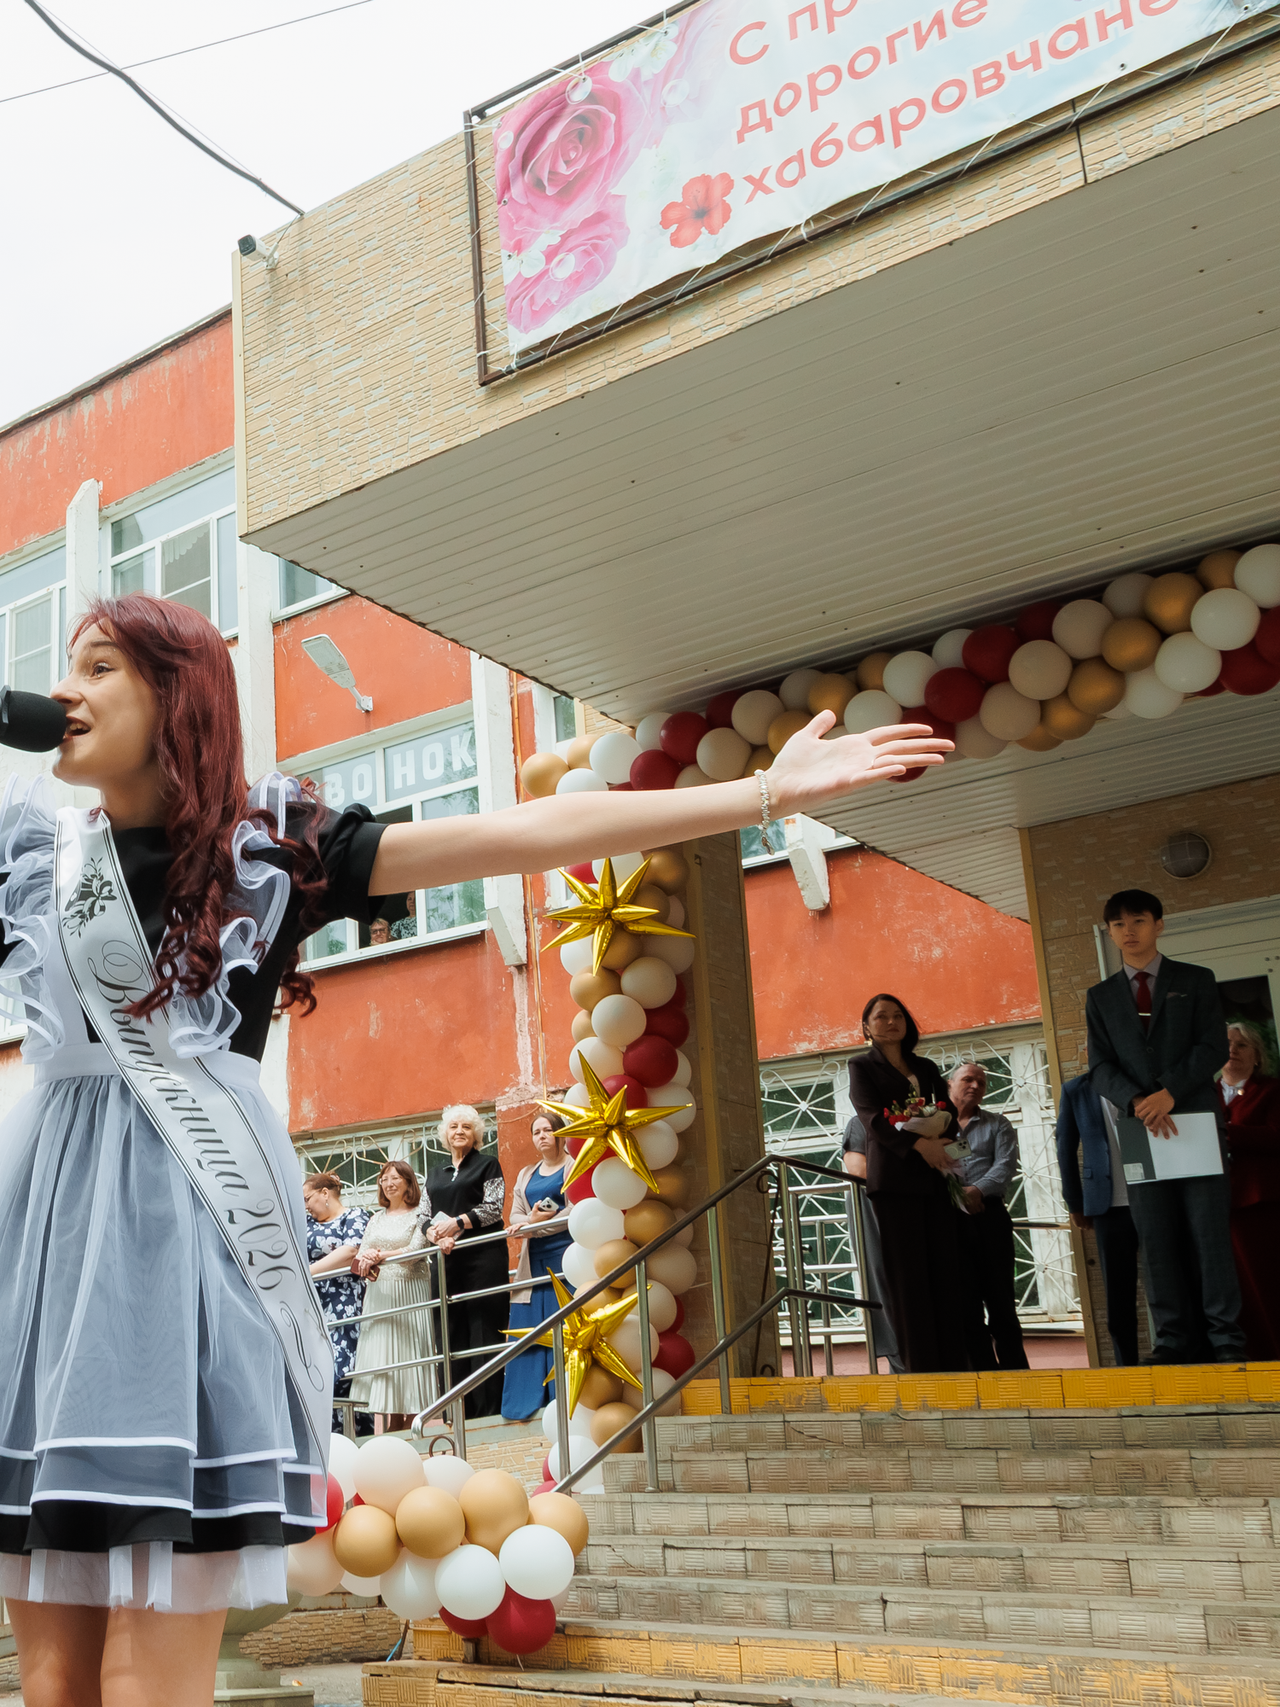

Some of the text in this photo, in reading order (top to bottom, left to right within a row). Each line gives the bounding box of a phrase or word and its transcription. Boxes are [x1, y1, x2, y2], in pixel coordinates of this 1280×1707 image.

[729, 21, 770, 65] С
[736, 0, 988, 144] дорогие
[223, 1198, 297, 1291] 2026
